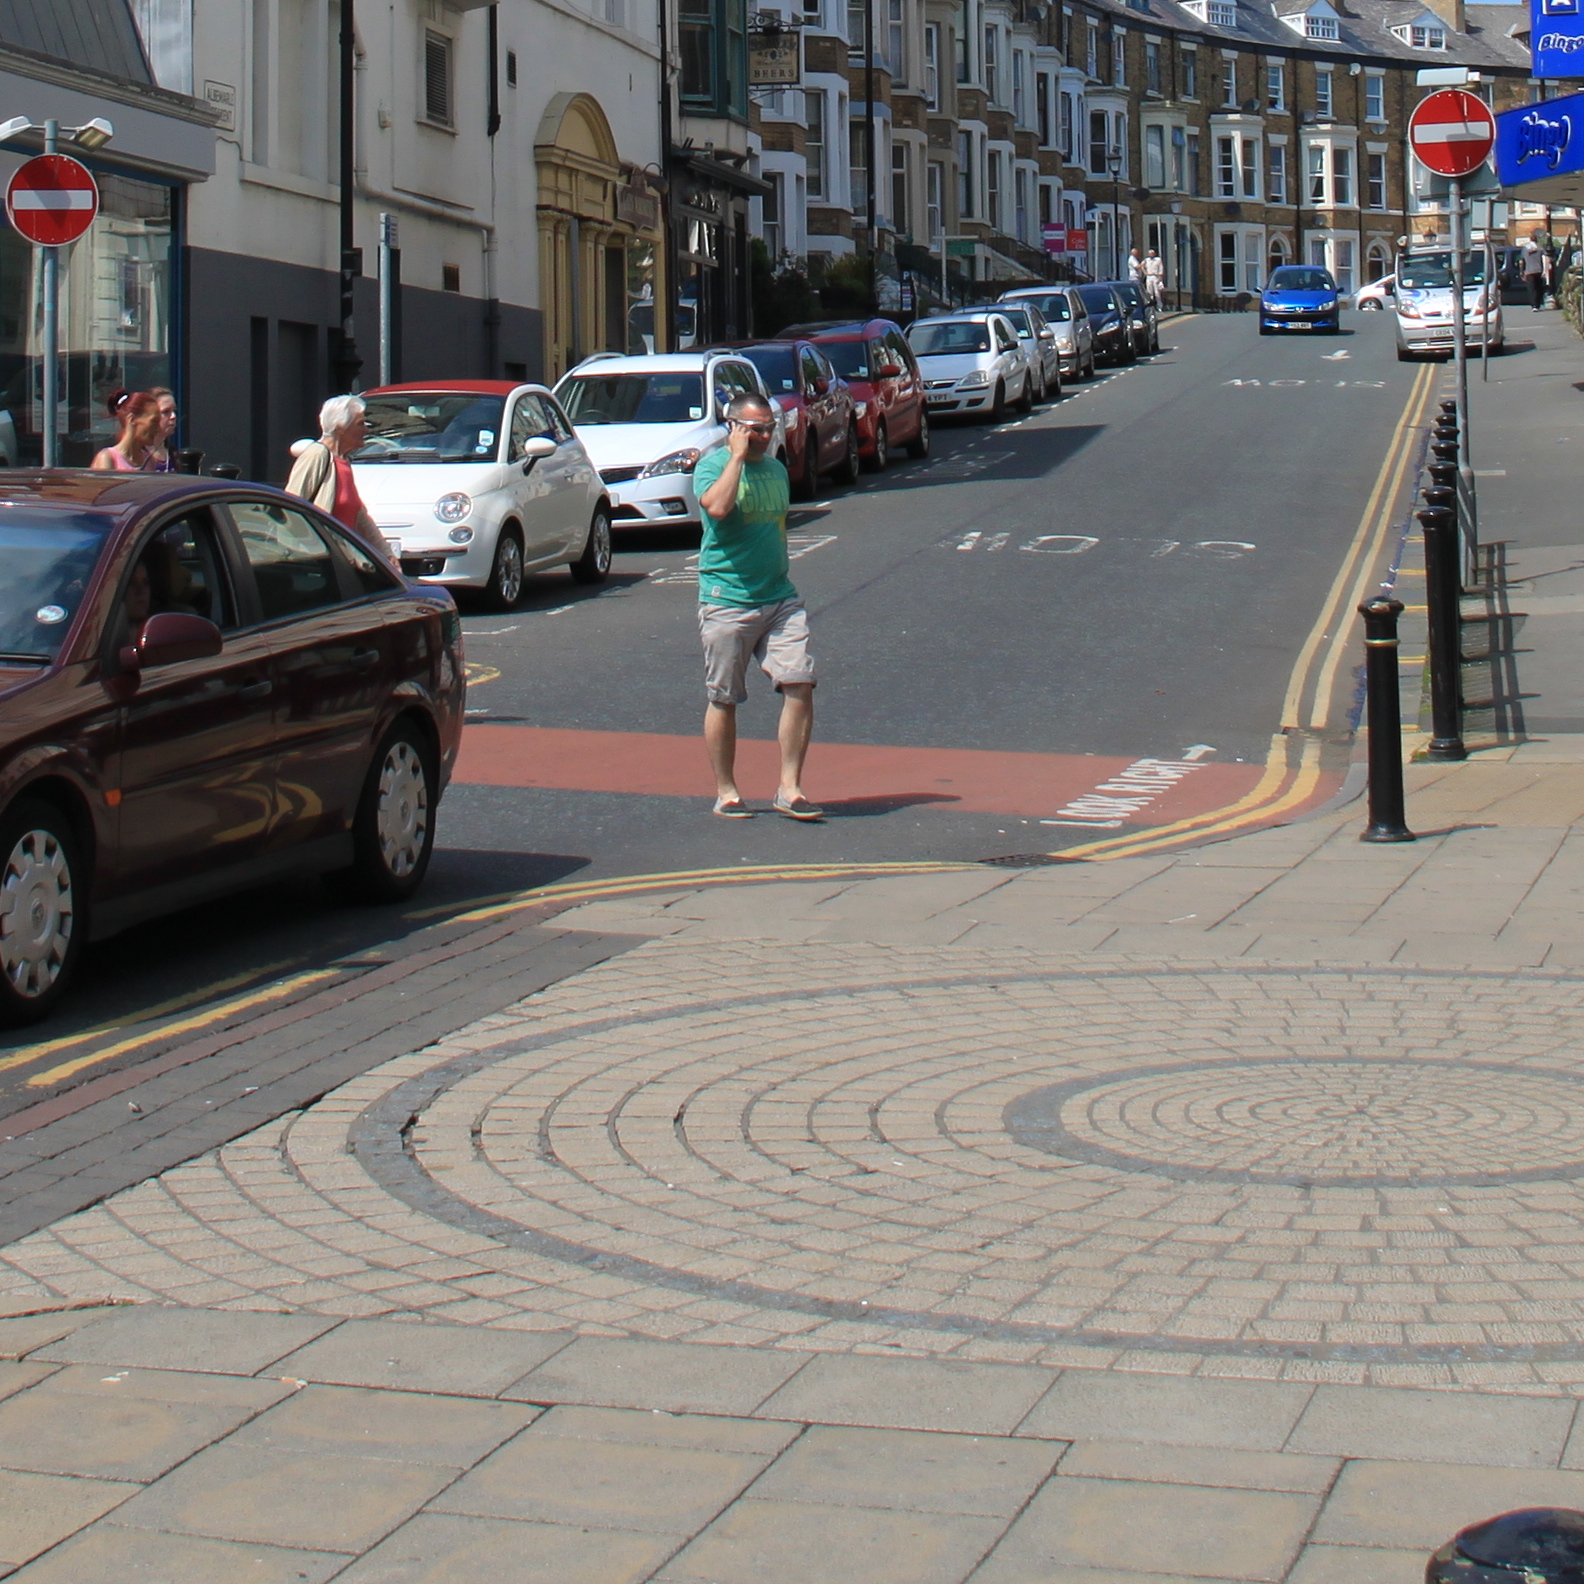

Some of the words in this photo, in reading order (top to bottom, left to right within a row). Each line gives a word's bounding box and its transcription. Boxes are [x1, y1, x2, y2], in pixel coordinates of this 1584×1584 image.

[754, 69, 794, 78] BEERS
[1518, 112, 1570, 169] Bingo
[903, 271, 910, 280] P
